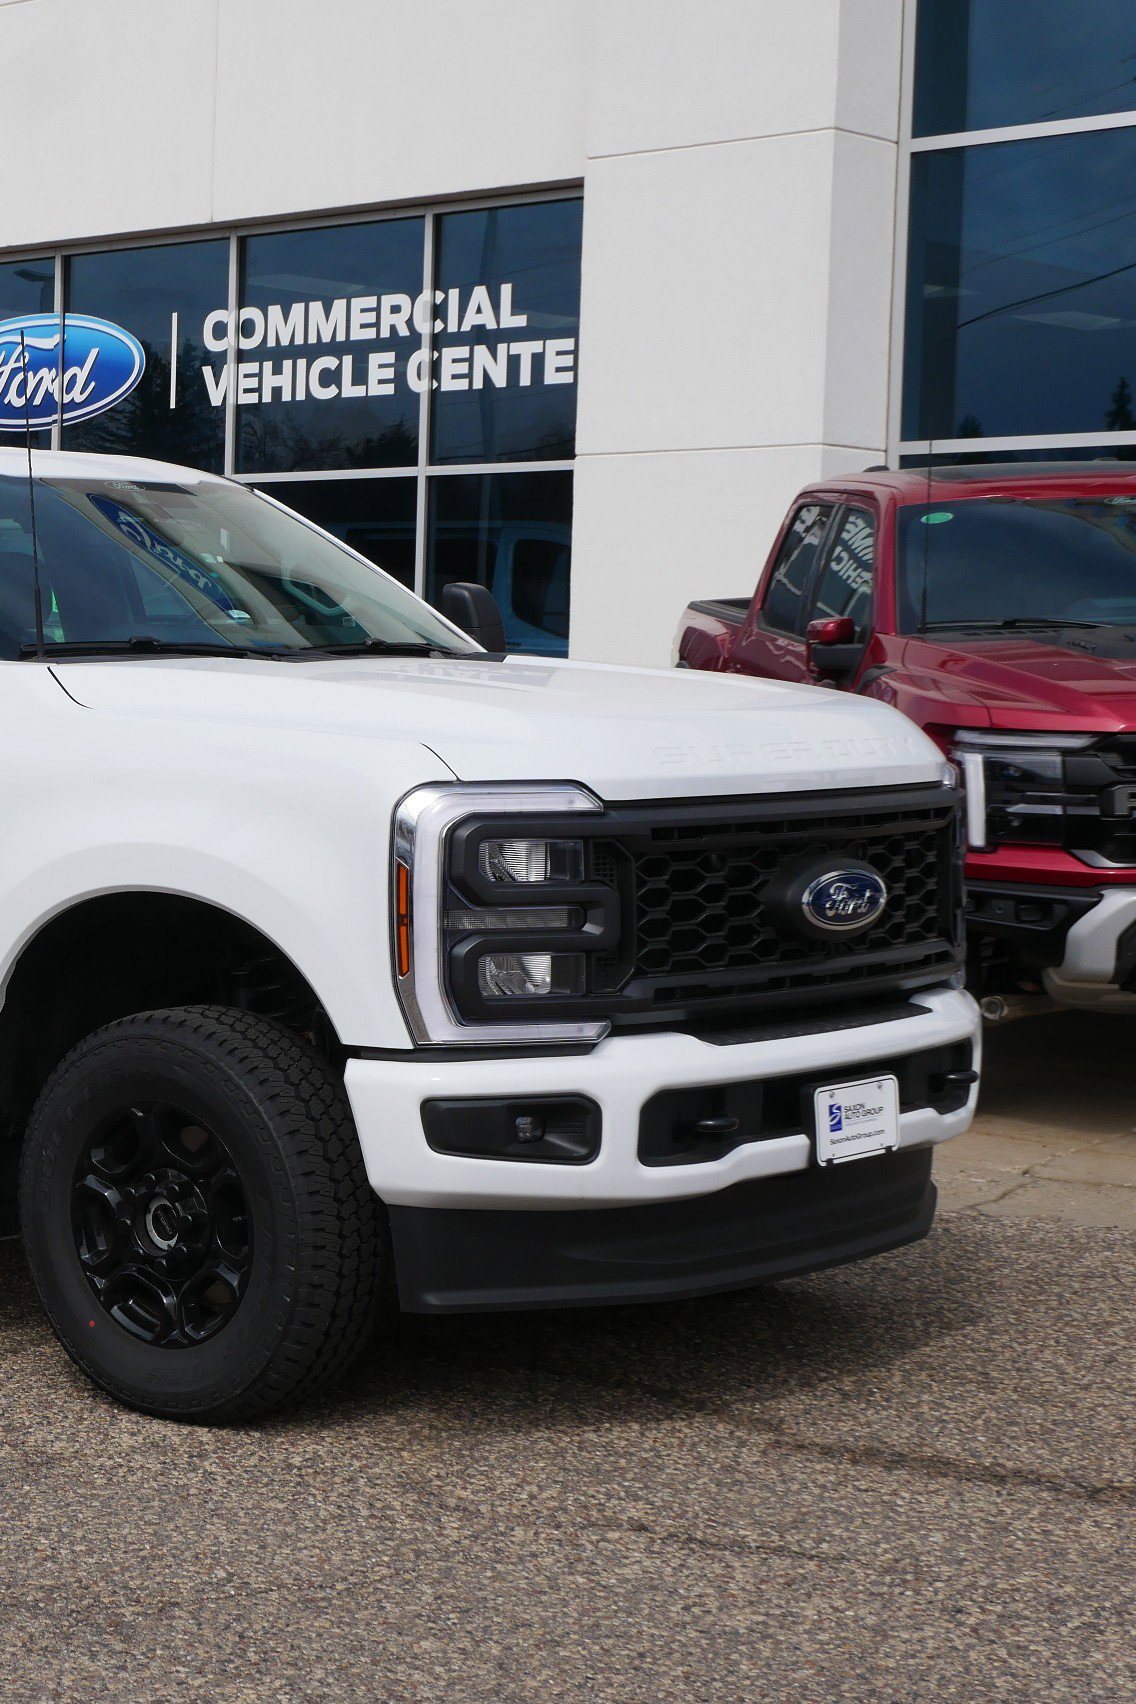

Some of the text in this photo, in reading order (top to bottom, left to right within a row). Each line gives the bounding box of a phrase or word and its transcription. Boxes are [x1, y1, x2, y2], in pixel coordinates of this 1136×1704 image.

[203, 283, 528, 352] COMMERCIAL
[202, 351, 396, 407] VEHICLE
[825, 882, 872, 917] Ford
[844, 1103, 864, 1113] SAXON
[845, 1106, 884, 1120] AUTO GROUP
[830, 1129, 885, 1145] SaxonAutoGroup.com
